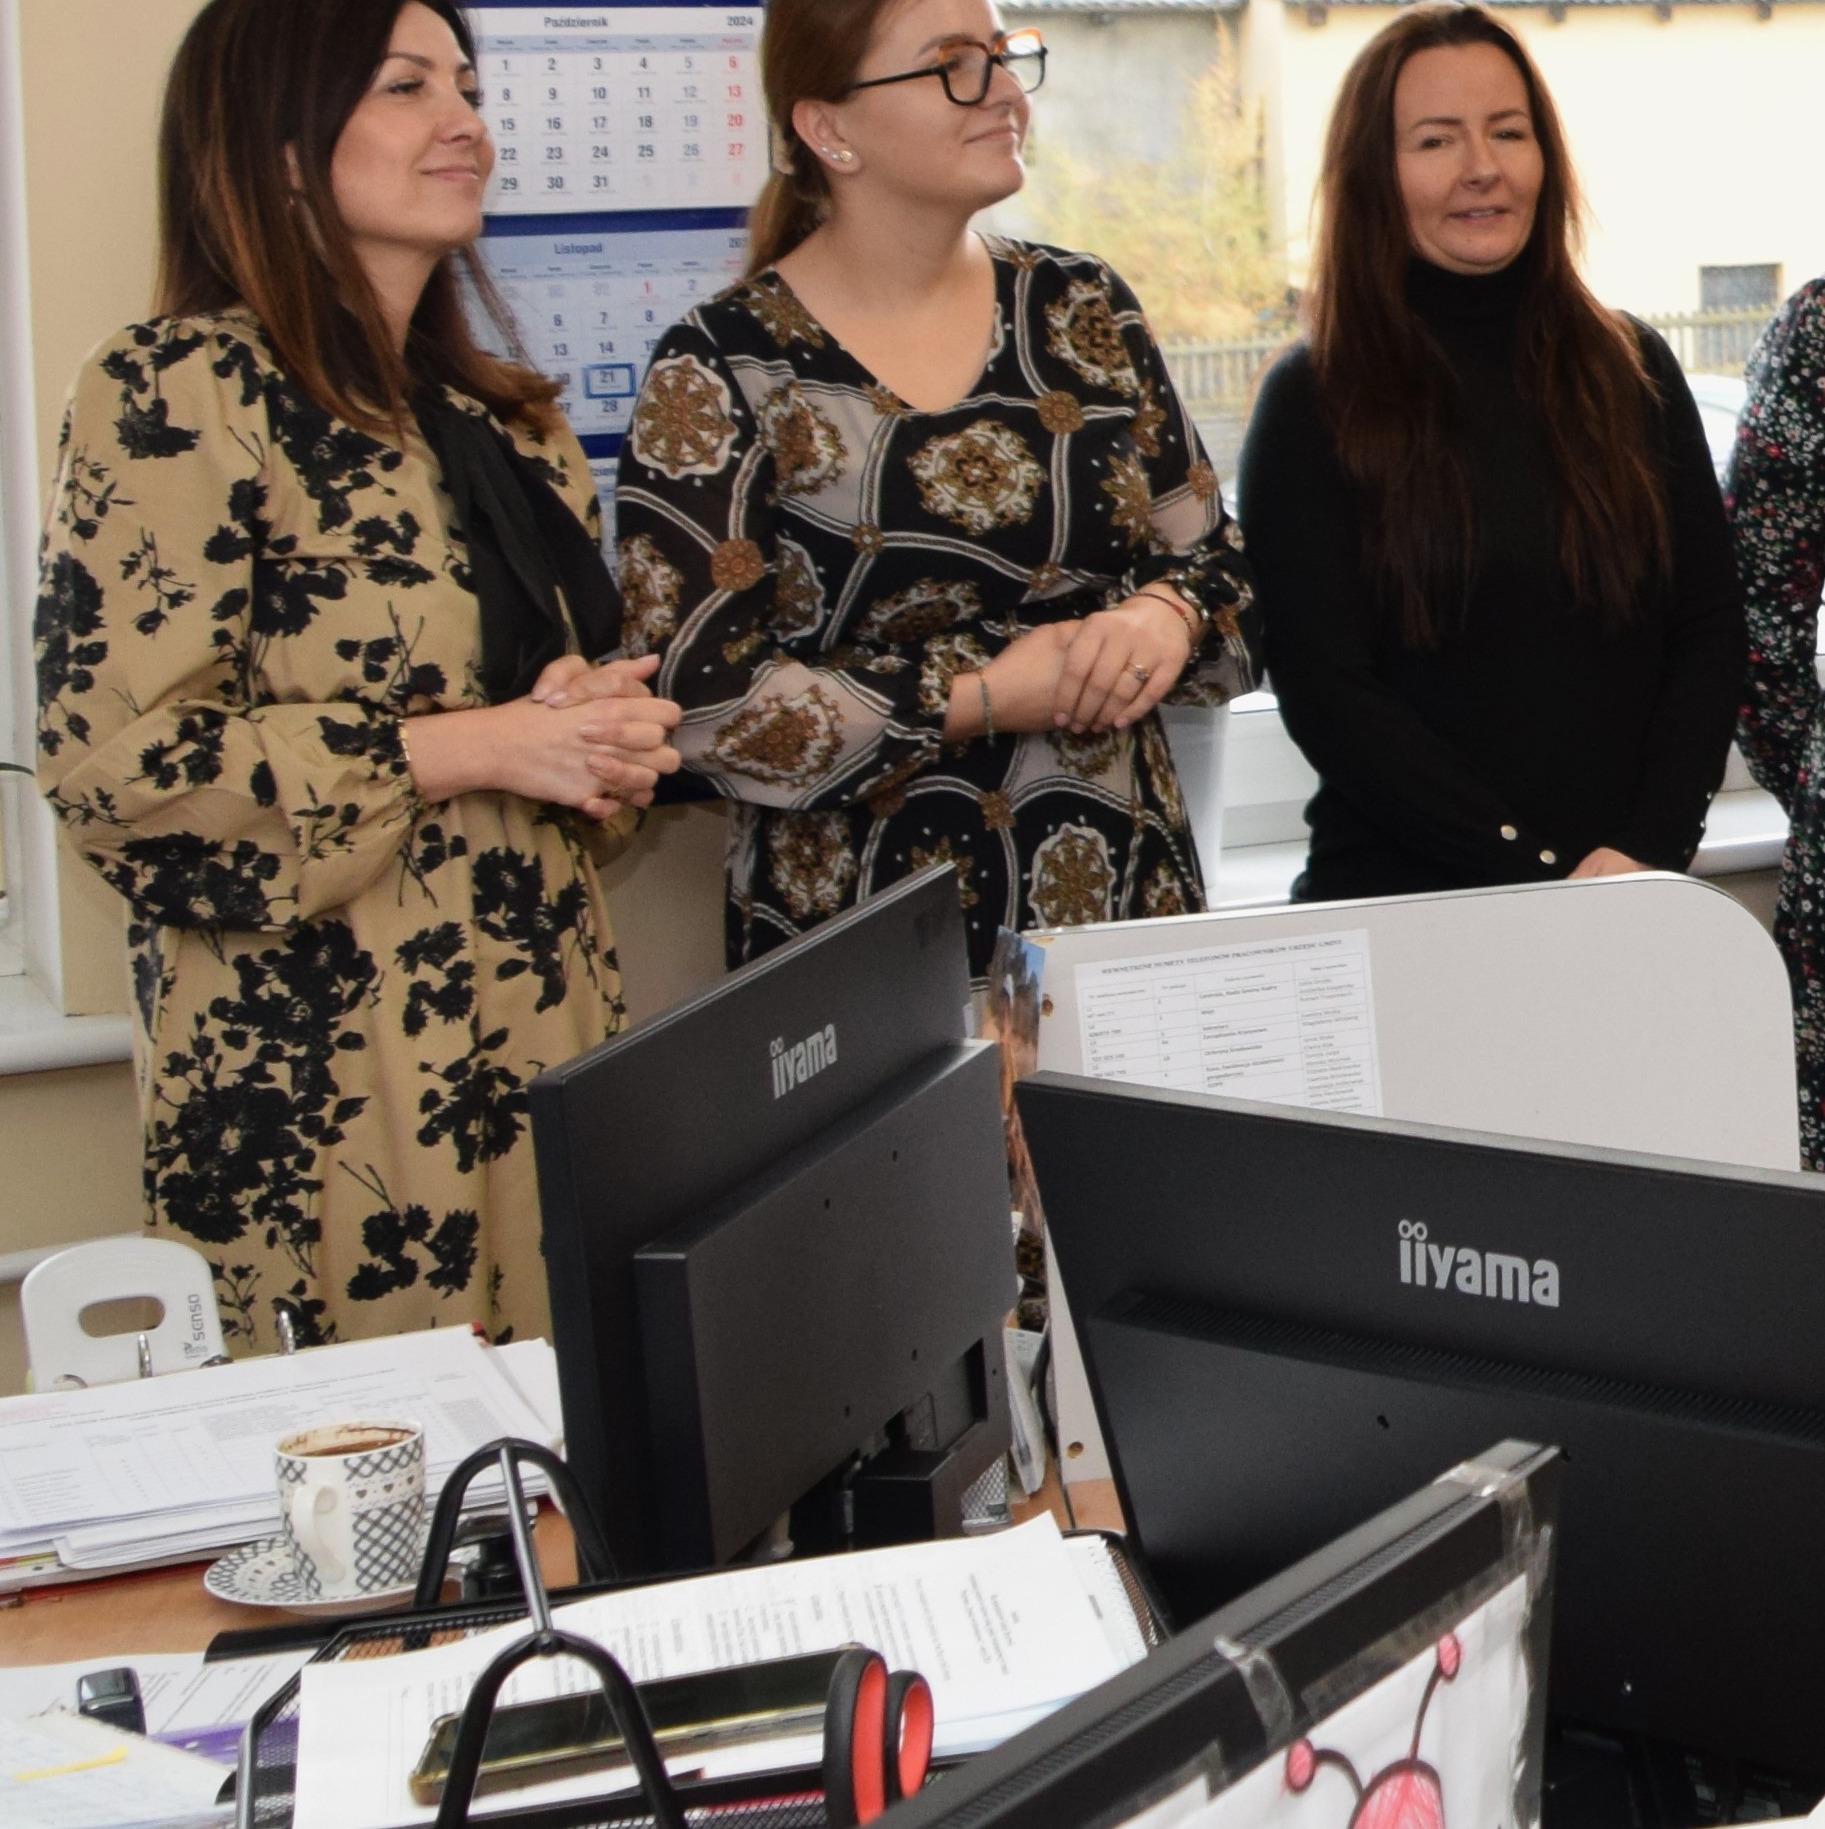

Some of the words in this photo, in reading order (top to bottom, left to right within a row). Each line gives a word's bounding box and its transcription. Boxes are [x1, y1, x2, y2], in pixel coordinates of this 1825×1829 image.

[545, 17, 607, 27] Październik
[727, 16, 753, 26] 2024
[502, 59, 508, 70] 1
[548, 59, 556, 69] 2
[594, 58, 601, 69] 3
[640, 58, 647, 68] 4
[685, 58, 692, 68] 5
[729, 57, 737, 68] 6
[503, 89, 510, 100] 8
[549, 88, 556, 99] 9
[593, 88, 606, 98] 10
[638, 87, 650, 98] 11
[683, 87, 696, 97] 12
[728, 86, 741, 97] 13
[501, 118, 515, 130] 15
[547, 118, 561, 129] 16
[593, 117, 606, 128] 17
[639, 116, 652, 127] 18
[684, 115, 697, 127] 19
[727, 114, 743, 126] 20
[501, 148, 516, 160] 22
[547, 147, 562, 158] 23
[592, 146, 608, 157] 24
[638, 145, 654, 157] 25
[684, 144, 698, 156] 26
[728, 143, 743, 155] 27
[501, 178, 517, 189] 29
[547, 177, 563, 188] 30
[593, 176, 608, 187] 31
[554, 244, 603, 255] Listopad
[644, 282, 650, 293] 1
[688, 280, 696, 291] 2
[554, 314, 561, 326] 6
[600, 312, 607, 324] 7
[645, 310, 653, 321] 8
[554, 344, 567, 355] 13
[599, 342, 613, 354] 14
[601, 372, 614, 382] 21
[602, 400, 618, 412] 28
[770, 1024, 836, 1099] iiyama
[1398, 1219, 1560, 1308] iiyama
